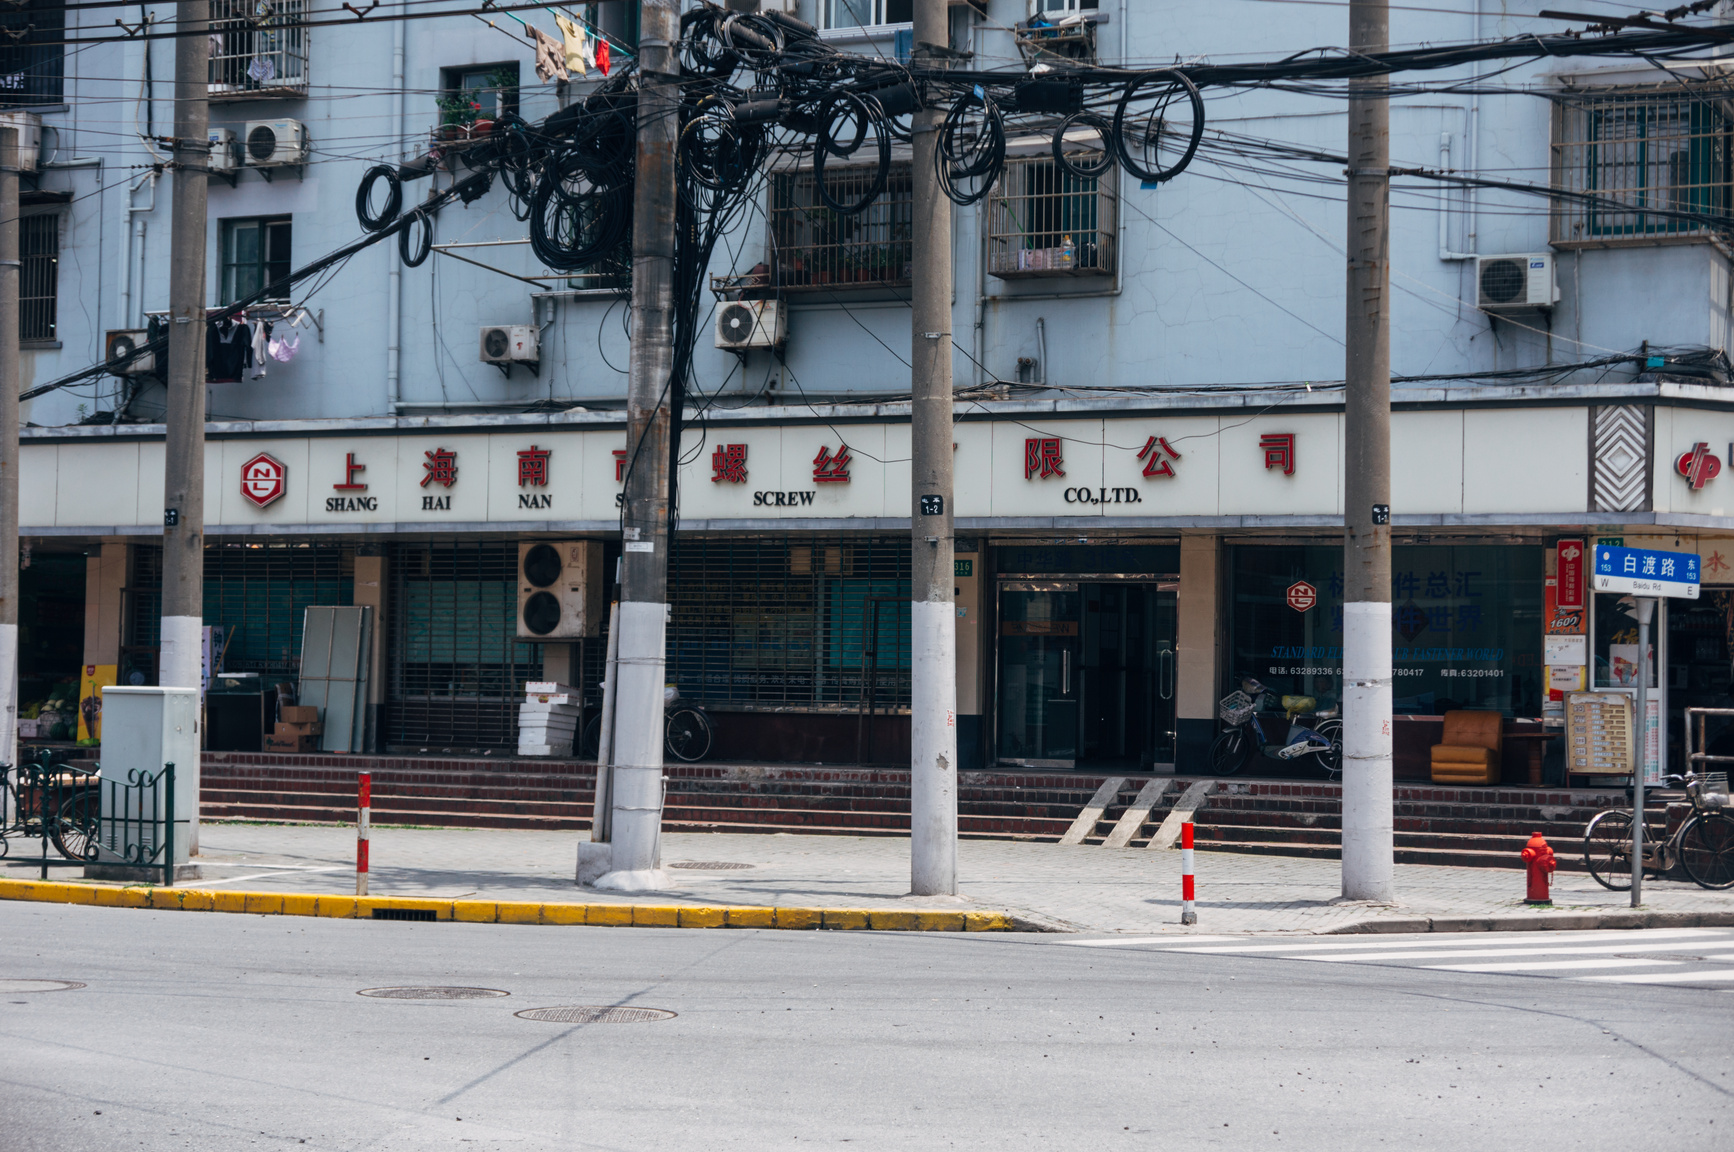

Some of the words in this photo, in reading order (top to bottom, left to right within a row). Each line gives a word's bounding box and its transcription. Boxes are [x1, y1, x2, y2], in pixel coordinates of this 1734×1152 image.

[333, 434, 1297, 491] 上海南螺丝限公司
[326, 497, 378, 512] SHANG
[421, 495, 452, 511] HAI
[518, 494, 553, 509] NAN
[753, 490, 816, 507] SCREW
[1064, 487, 1142, 505] CO.,LTD.
[925, 505, 939, 514] 1-2
[954, 562, 970, 571] 316
[1623, 553, 1676, 577] 白渡路
[1687, 558, 1696, 571] 东
[1702, 550, 1731, 573] 水
[1601, 563, 1612, 572] 153
[1686, 572, 1697, 581] 153
[1328, 571, 1483, 598] 标件总汇
[1601, 578, 1610, 587] W
[1633, 580, 1650, 590] Baidu
[1687, 586, 1693, 596] E
[1550, 616, 1578, 628] 1600
[1270, 646, 1326, 659] STANDARD
[1412, 647, 1464, 661] FASTENER
[1466, 647, 1504, 661] WORLD
[1290, 667, 1333, 675] 63289336
